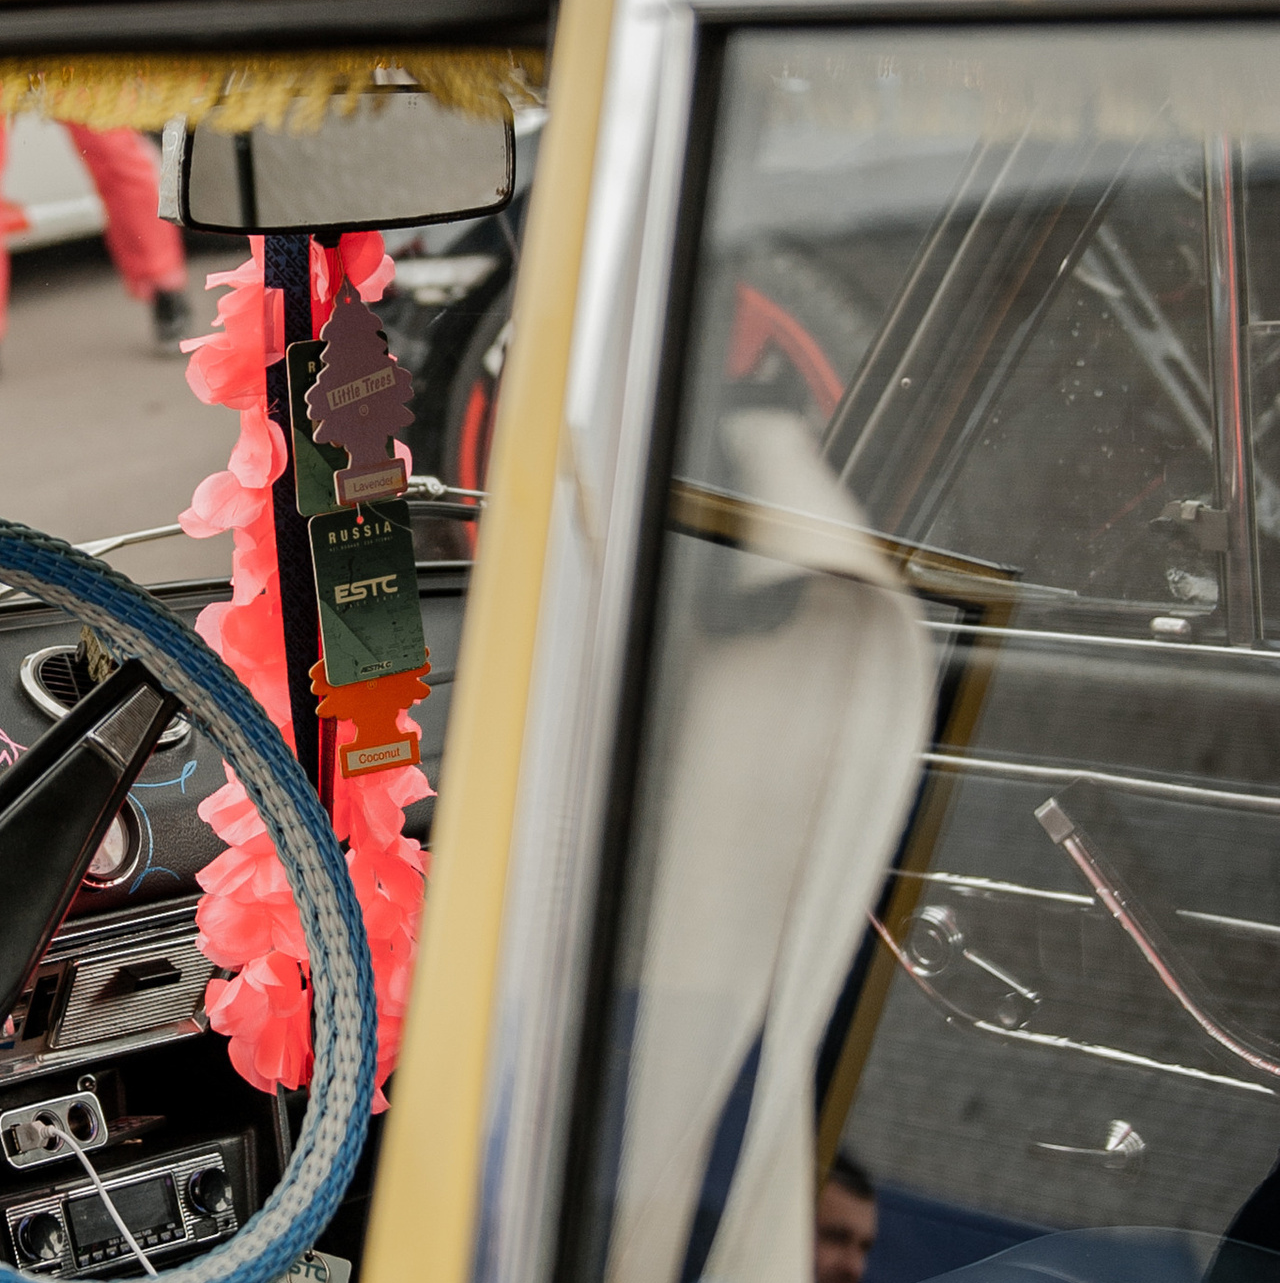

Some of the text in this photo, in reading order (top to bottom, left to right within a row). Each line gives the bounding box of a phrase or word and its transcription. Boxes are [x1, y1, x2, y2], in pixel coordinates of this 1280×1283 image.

[332, 373, 393, 408] Little Trees
[353, 475, 394, 493] Lavender
[328, 521, 392, 545] RUSSIA
[334, 574, 399, 604] ESTC
[358, 748, 401, 764] Coconut
